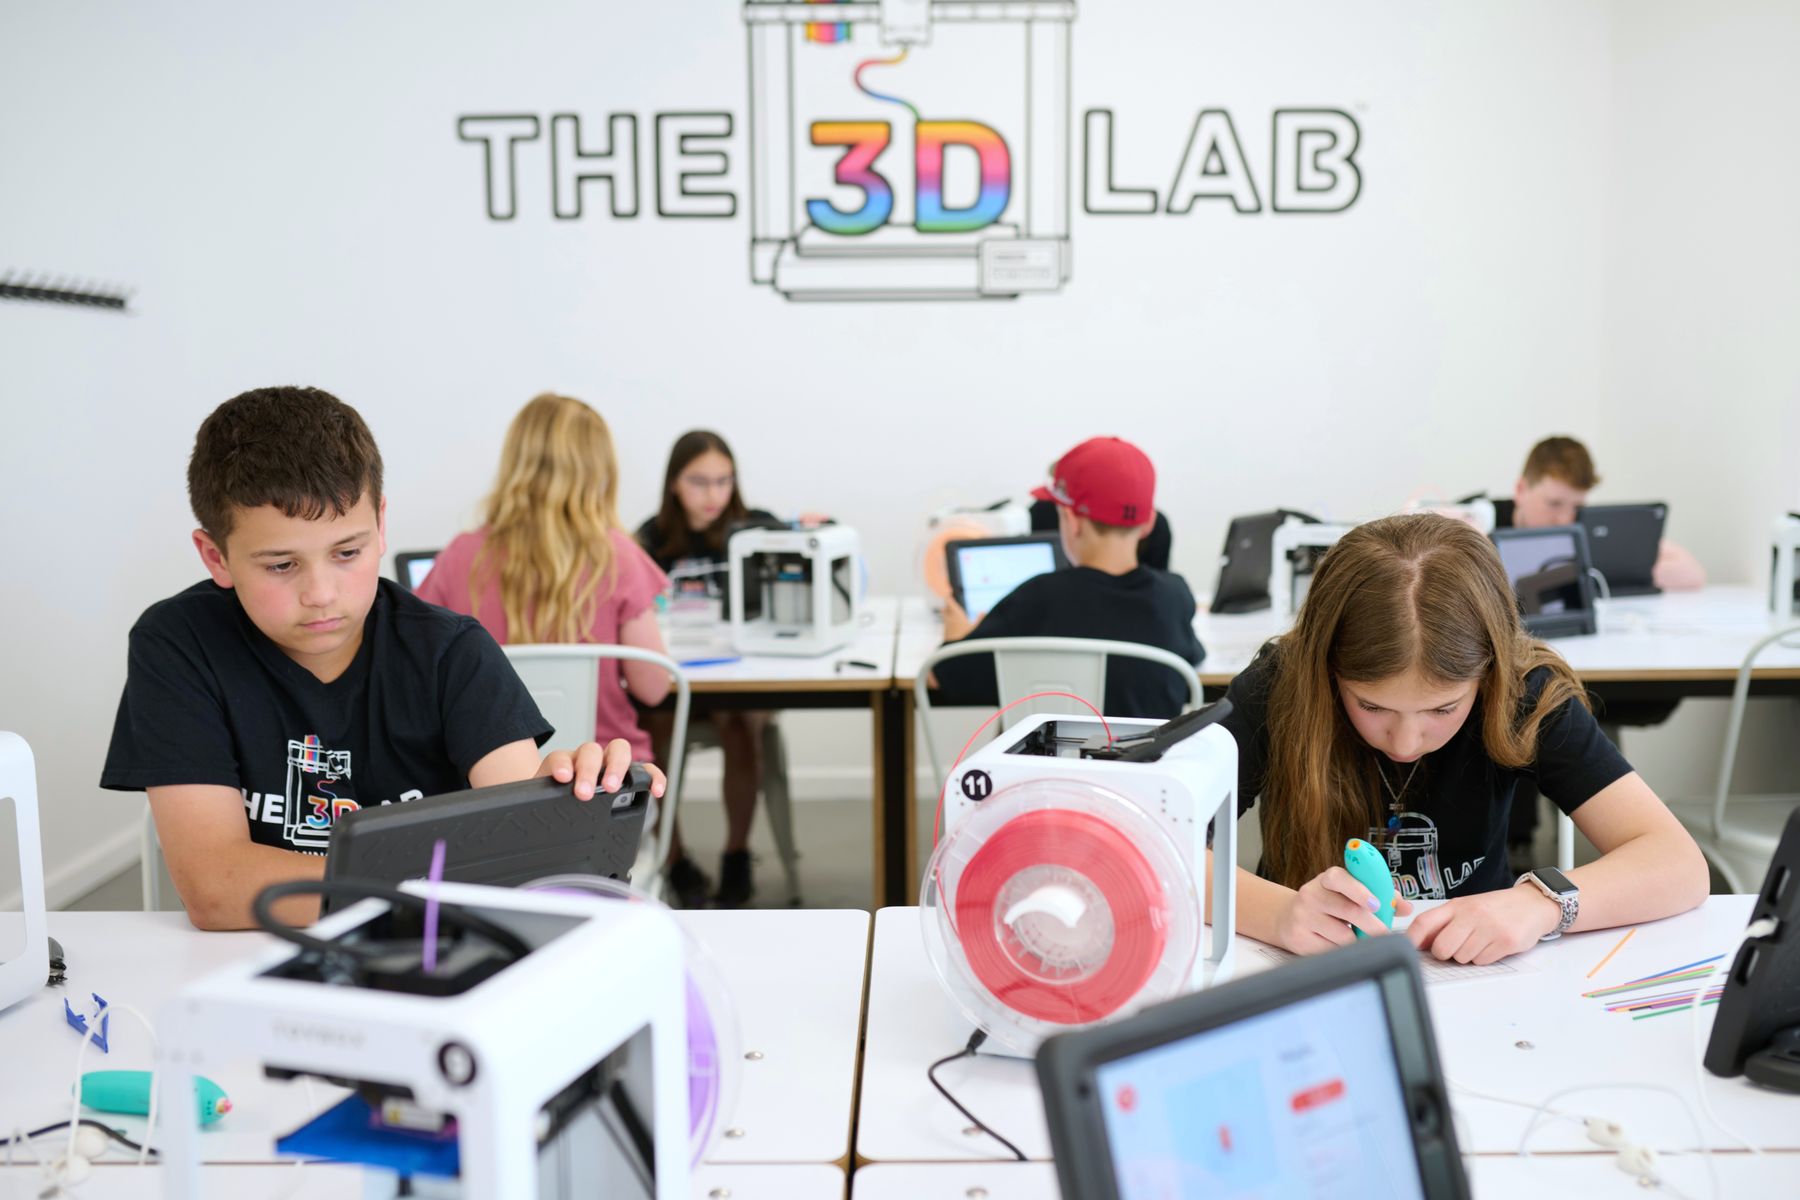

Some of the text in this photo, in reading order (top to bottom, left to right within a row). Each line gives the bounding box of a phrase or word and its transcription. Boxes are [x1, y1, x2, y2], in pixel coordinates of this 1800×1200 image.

[458, 108, 1362, 235] THE 3D LAB
[964, 774, 988, 797] 11
[241, 788, 285, 825] HE
